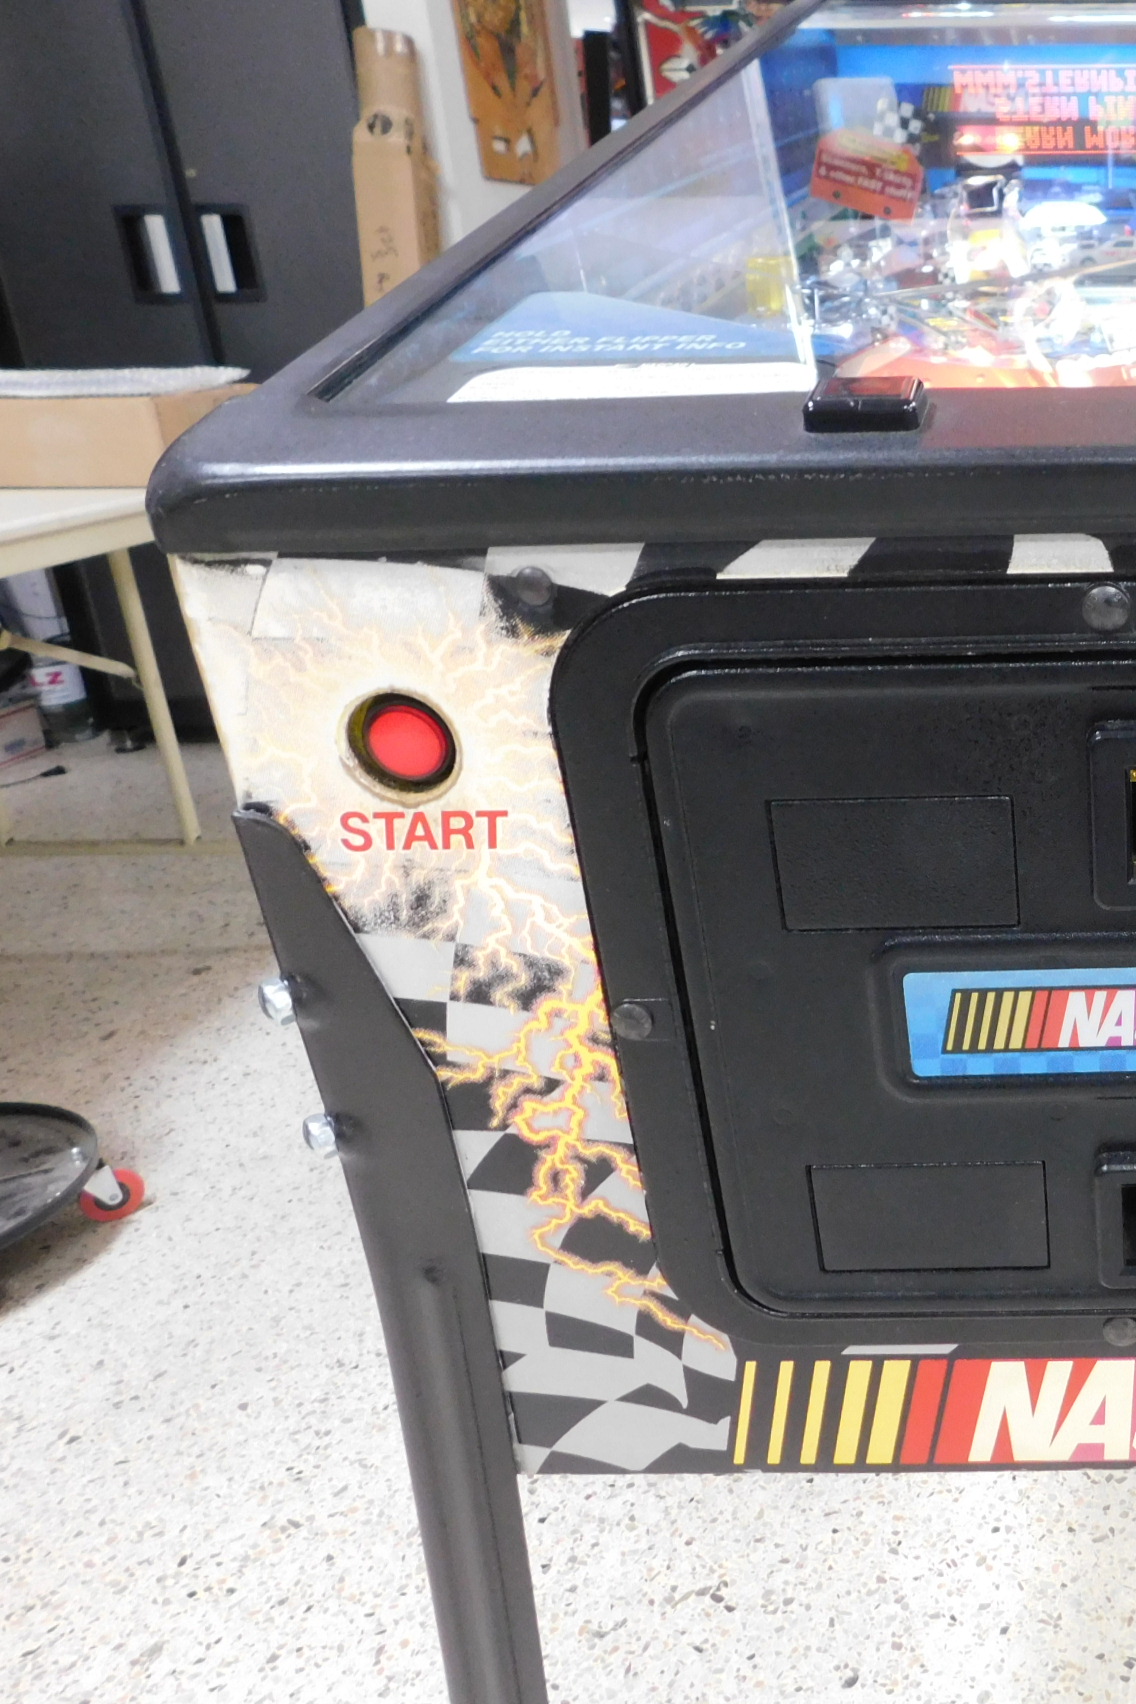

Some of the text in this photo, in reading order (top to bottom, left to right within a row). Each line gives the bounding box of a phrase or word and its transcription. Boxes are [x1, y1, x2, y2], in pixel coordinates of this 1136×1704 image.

[482, 334, 717, 346] EITHER FLIPPER
[491, 330, 571, 338] HOLD
[470, 341, 747, 354] FOR INSTANT INFO
[339, 809, 509, 853] START
